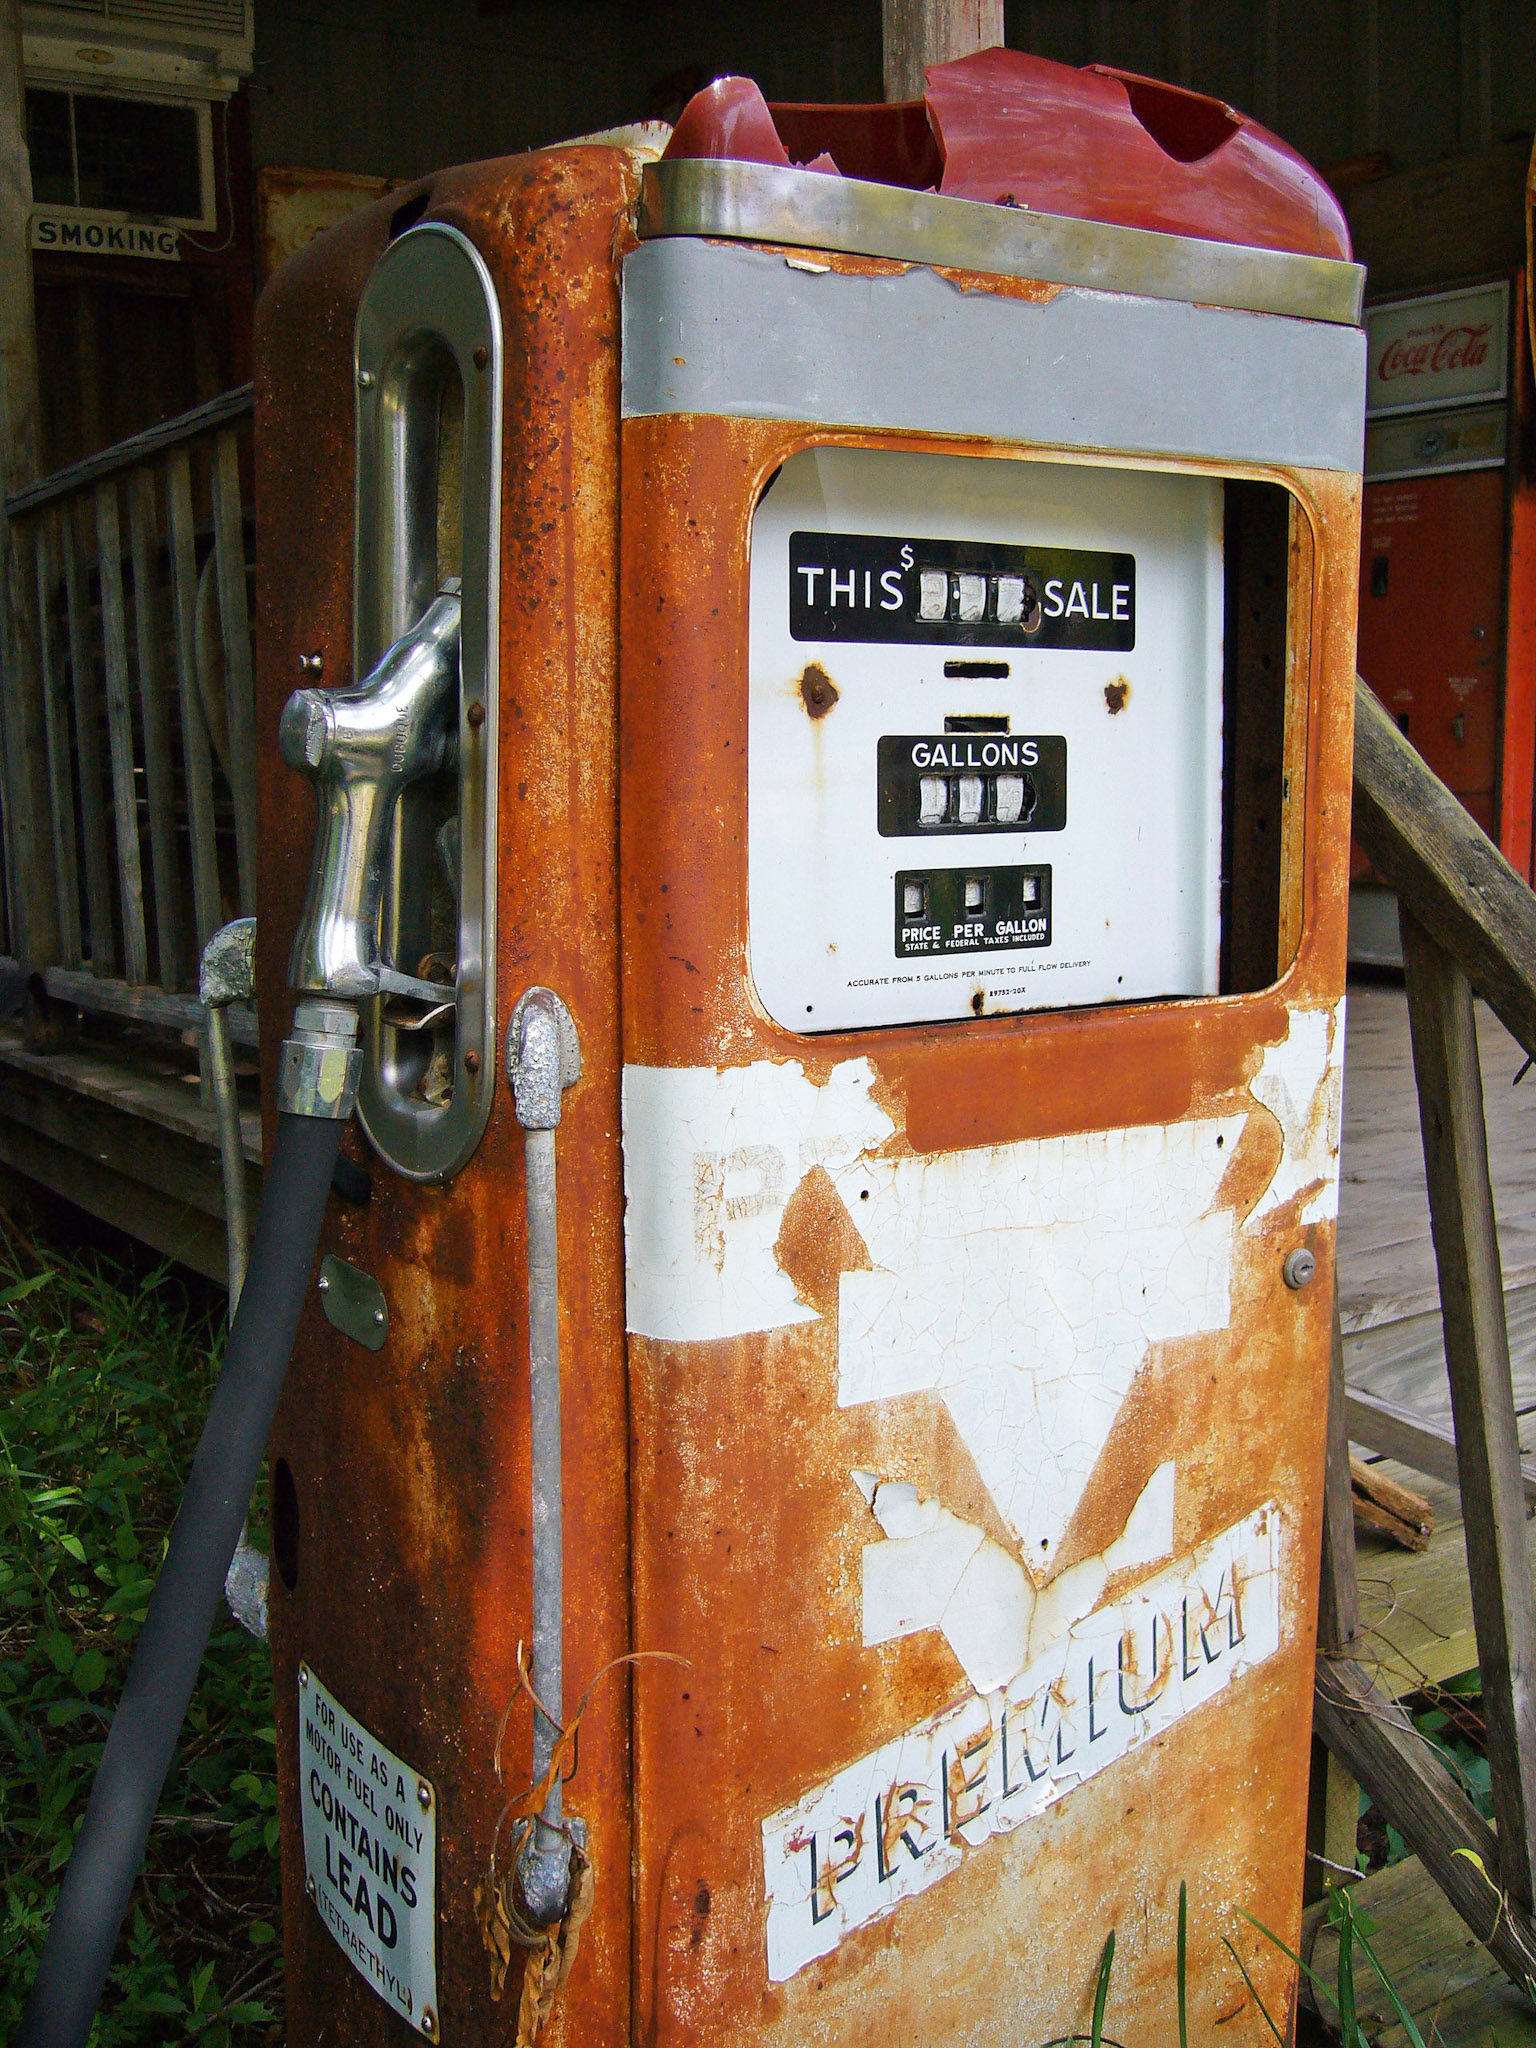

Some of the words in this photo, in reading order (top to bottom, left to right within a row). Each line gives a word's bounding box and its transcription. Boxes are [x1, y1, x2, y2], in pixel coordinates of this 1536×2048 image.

[38, 221, 174, 254] SMOKING
[1378, 323, 1492, 381] Coca-Cola
[797, 567, 904, 611] THIS
[900, 544, 914, 571] $
[1043, 580, 1130, 620] SALE
[391, 706, 409, 773] DUBUQUE
[911, 742, 1038, 767] GALLONS
[902, 926, 941, 942] PRICE
[953, 923, 984, 939] PER
[995, 918, 1047, 935] GALLON
[904, 942, 929, 952] STATE
[932, 941, 940, 949] &
[945, 938, 980, 949] FEDERAL
[983, 935, 1009, 945] TAXES
[1012, 932, 1045, 943] INCLUDED
[847, 977, 889, 987] ACCURATE
[892, 976, 913, 984] FROM
[924, 973, 959, 981] GALLONS
[961, 970, 975, 978] PER
[978, 968, 1004, 977] MINUTE
[1018, 964, 1036, 973] FULL
[1039, 963, 1058, 971] FLOW
[1060, 960, 1091, 969] DELIVERY
[315, 1693, 335, 1735] FOR
[341, 1723, 364, 1766] USE
[371, 1753, 388, 1787] AS
[396, 1775, 405, 1803] A
[808, 1567, 1248, 1926] PREMIUM
[306, 1717, 341, 1779] MOTOR
[347, 1767, 378, 1817] FUEL
[385, 1805, 423, 1854] ONLY
[310, 1768, 417, 1908] CONTAINS
[325, 1834, 397, 1949] LEAD
[318, 1884, 413, 2015] (TETRAETHYL)
